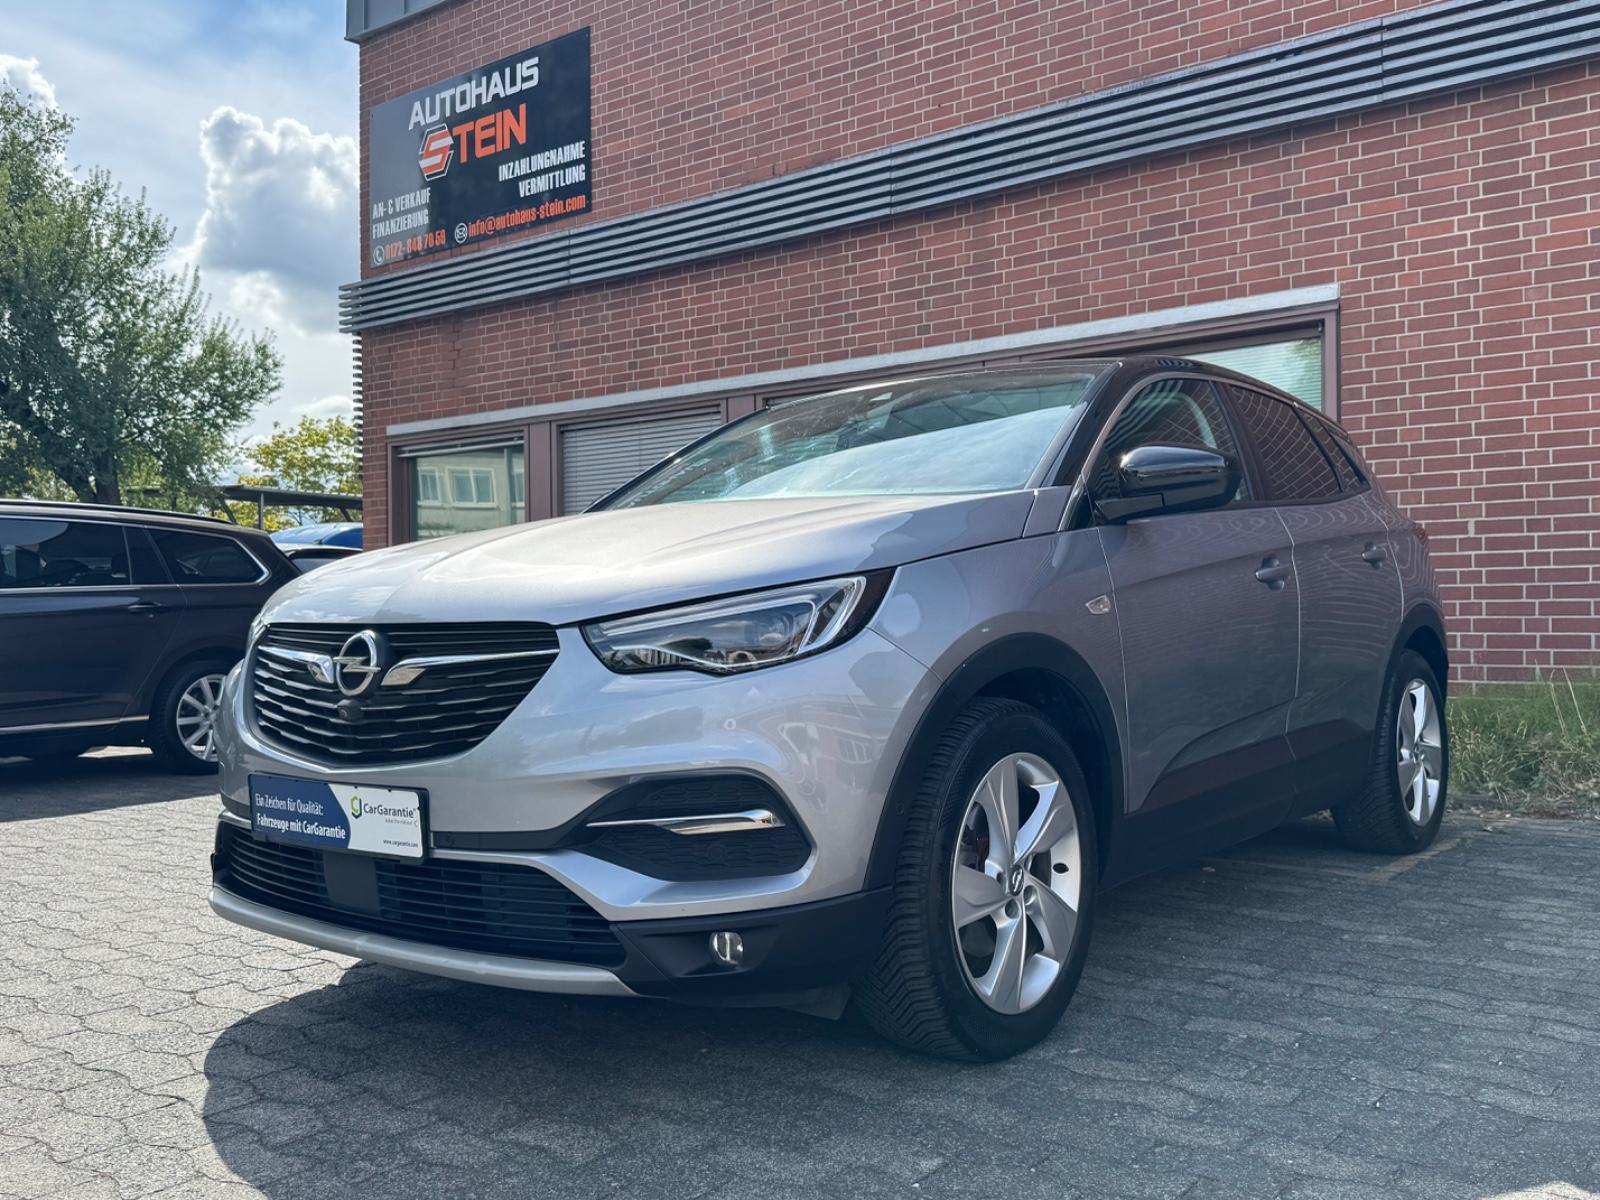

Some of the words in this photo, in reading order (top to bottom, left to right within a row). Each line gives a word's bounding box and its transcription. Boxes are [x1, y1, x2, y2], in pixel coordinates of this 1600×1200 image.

[408, 57, 540, 131] AUTOHAUS
[419, 103, 527, 178] STEIN
[498, 140, 586, 182] INZAHLUNGNAHME
[518, 164, 586, 198] VERMITTLUNG
[372, 203, 387, 220] AN-
[388, 199, 394, 215] &
[394, 187, 431, 213] VERKAUF
[467, 194, 586, 237] info@autohaus-stein.com
[372, 208, 429, 240] FINANZIERUNG
[255, 793, 264, 807] Ein
[264, 795, 287, 810] Zeichen
[287, 797, 297, 812] für
[296, 799, 324, 816] Qualität:
[256, 812, 290, 833] Fahrzeuge
[289, 819, 302, 833] mit
[302, 820, 347, 839] CarGarantie
